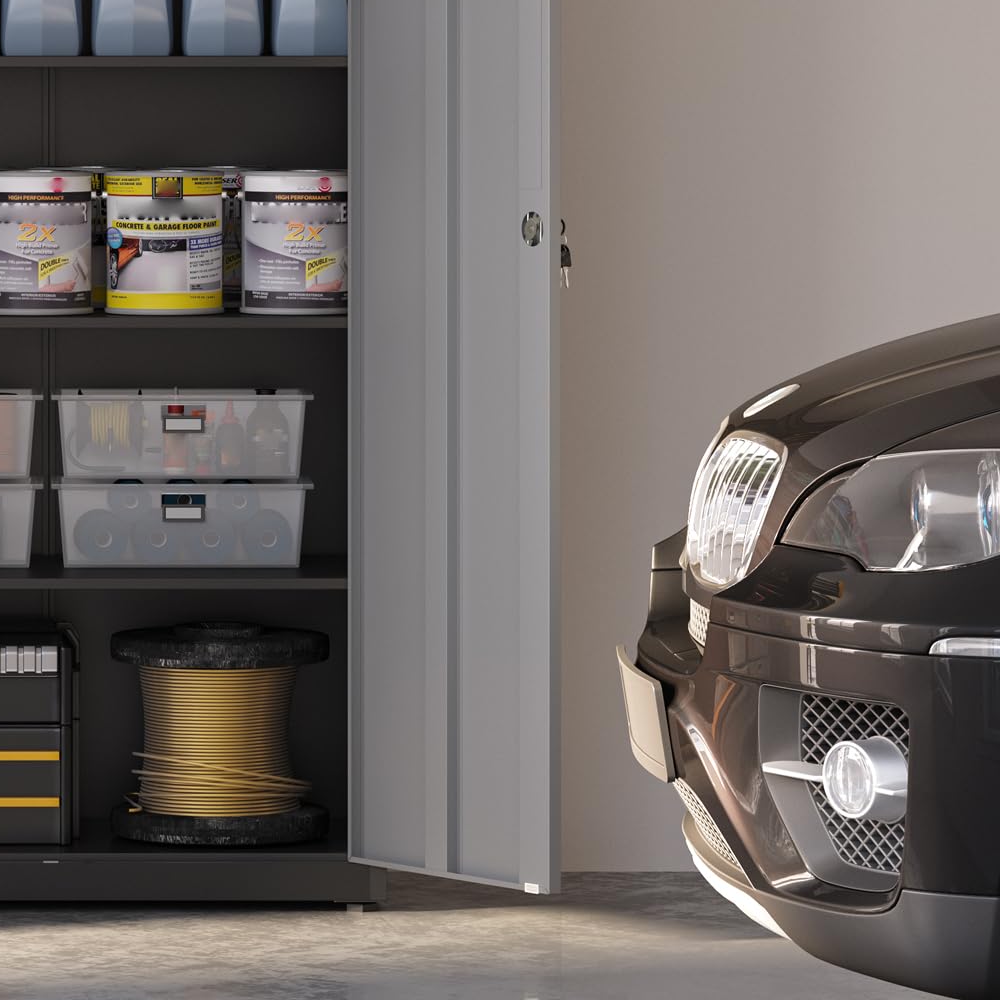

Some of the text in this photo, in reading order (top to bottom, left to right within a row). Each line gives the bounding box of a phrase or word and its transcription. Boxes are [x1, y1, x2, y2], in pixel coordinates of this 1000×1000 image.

[115, 221, 144, 230] CONCRETE
[153, 223, 181, 231] GARAGE
[182, 222, 202, 231] FLOOR
[40, 257, 61, 271] DOUBLE
[307, 257, 329, 270] DOUBLE
